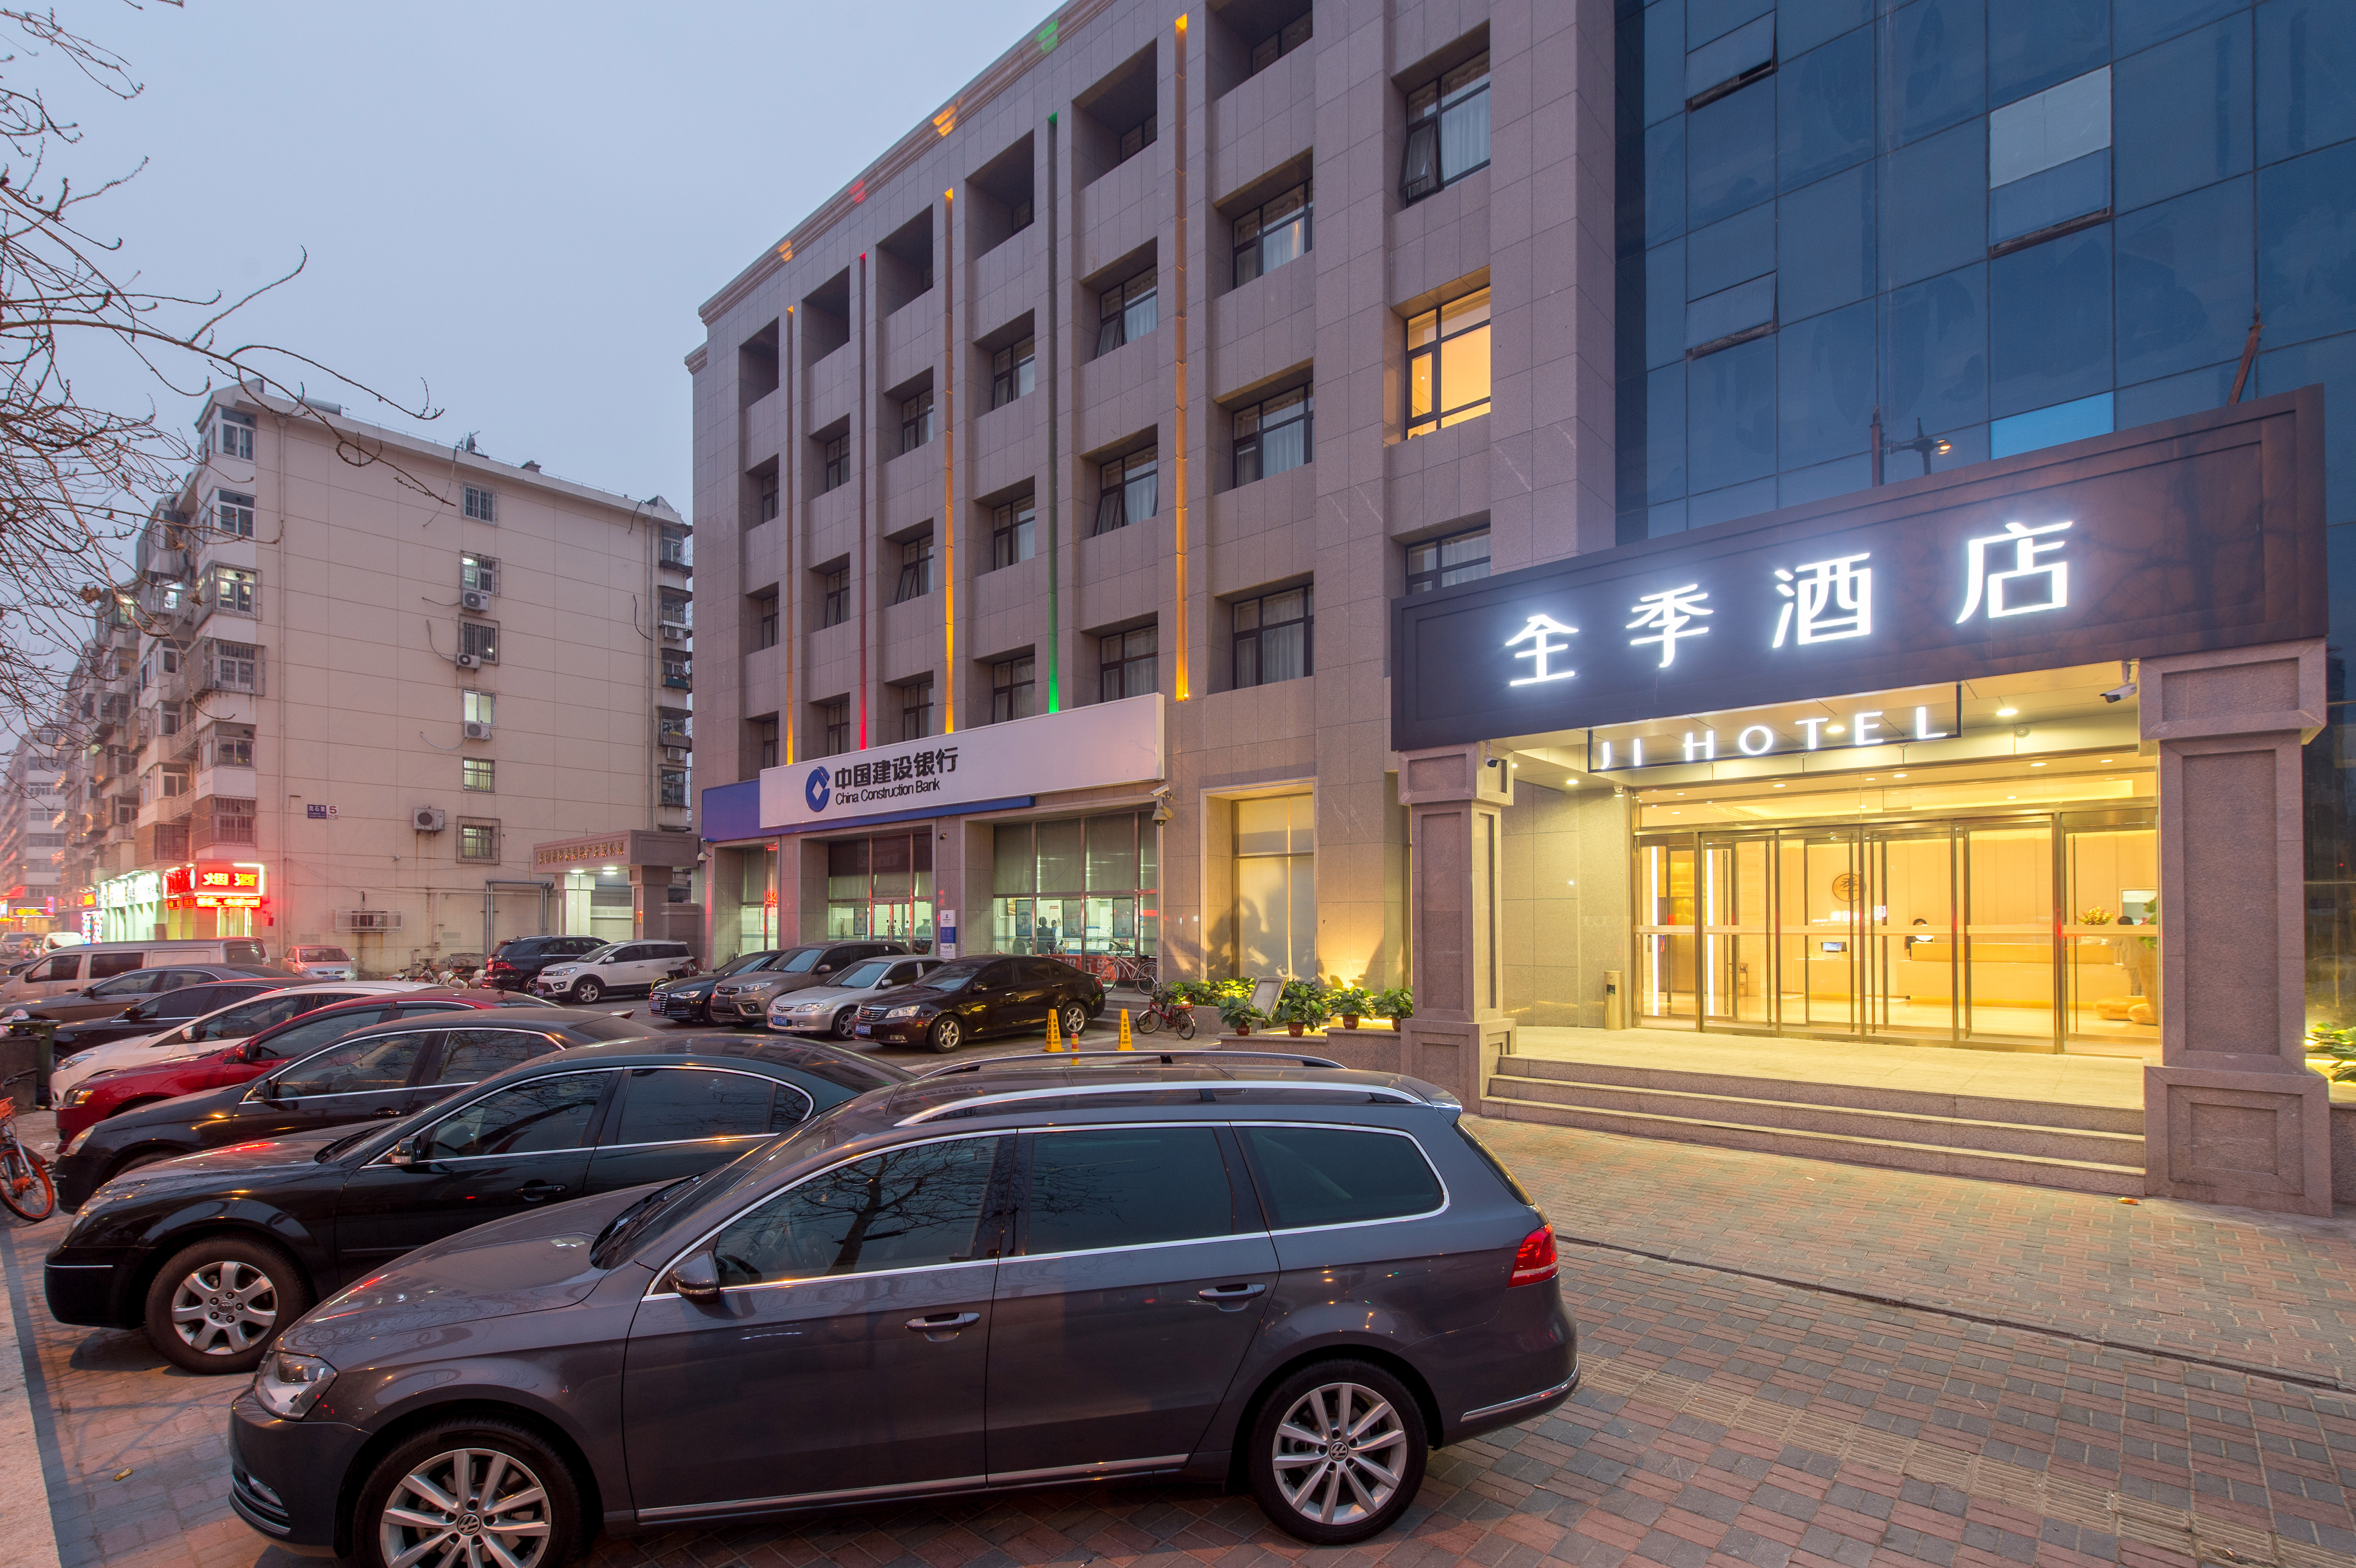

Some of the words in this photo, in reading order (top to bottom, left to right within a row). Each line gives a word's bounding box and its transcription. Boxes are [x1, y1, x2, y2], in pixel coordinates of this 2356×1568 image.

[1505, 521, 2073, 686] 全季酒店
[1600, 738, 1642, 770] JI
[1685, 707, 1949, 761] HOTEL
[835, 746, 959, 789] 中国建设银行
[835, 792, 859, 805] China
[860, 784, 914, 802] Construction
[915, 777, 940, 794] Bank
[329, 806, 337, 814] 5
[202, 872, 258, 887] 烟酒
